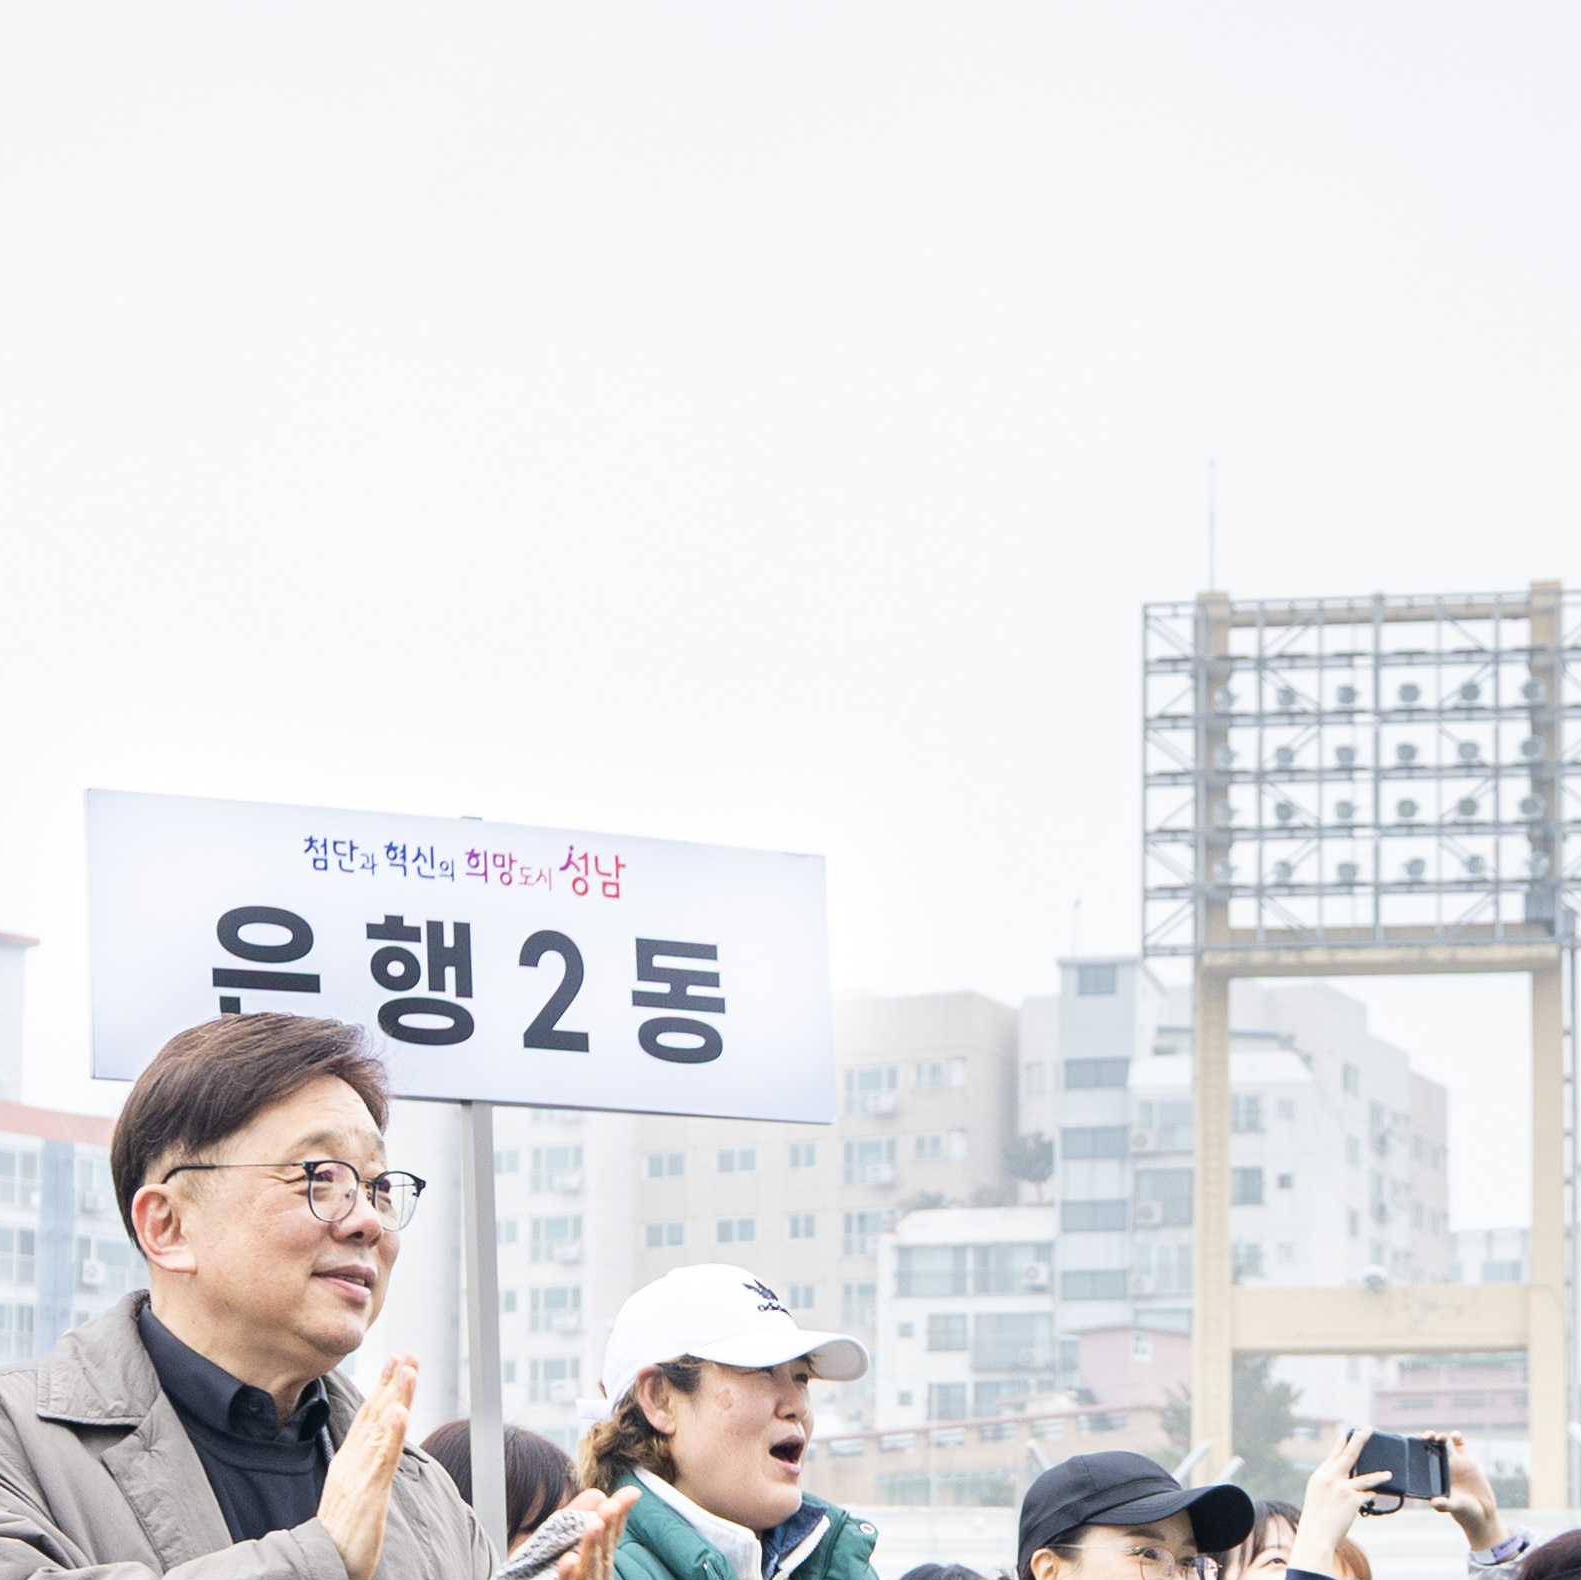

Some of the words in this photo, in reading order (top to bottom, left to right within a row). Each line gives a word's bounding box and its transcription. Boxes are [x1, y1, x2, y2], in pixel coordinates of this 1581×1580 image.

[304, 835, 378, 876] 첨단과
[384, 841, 455, 882] 혁신의
[465, 848, 553, 891] 희망도시
[559, 845, 626, 899] 성남
